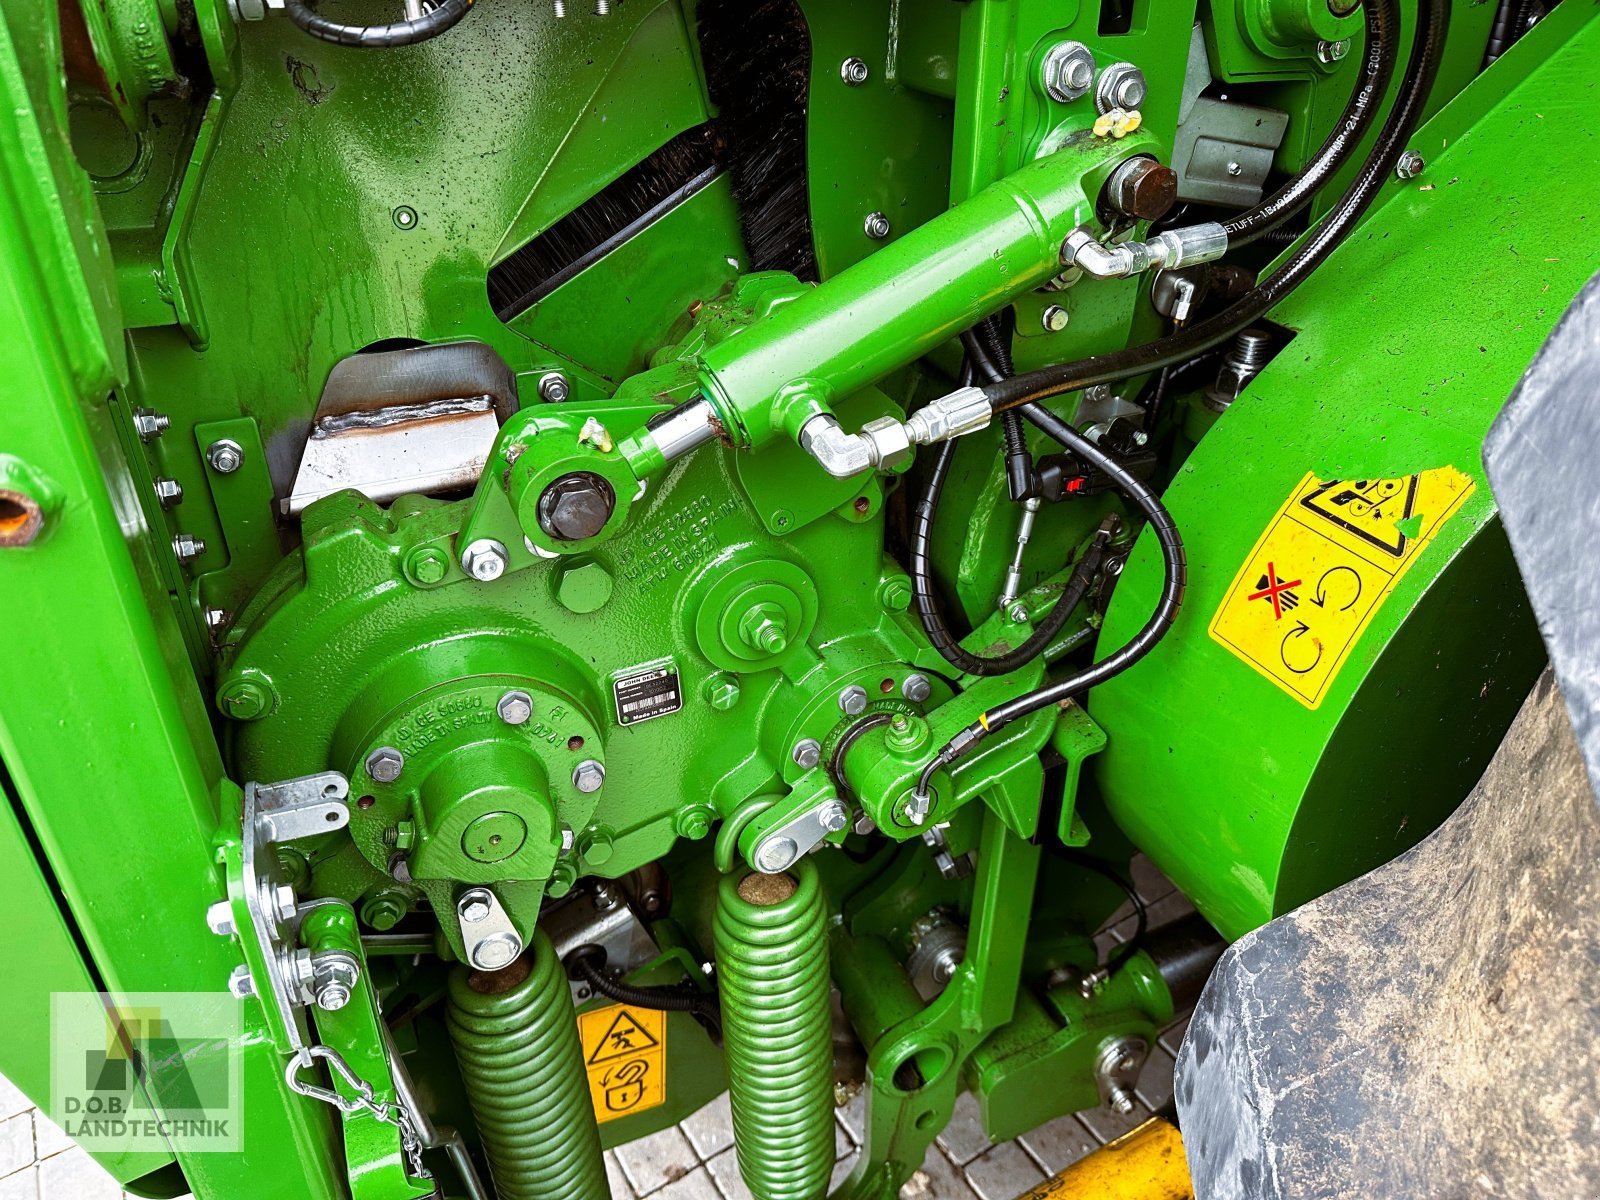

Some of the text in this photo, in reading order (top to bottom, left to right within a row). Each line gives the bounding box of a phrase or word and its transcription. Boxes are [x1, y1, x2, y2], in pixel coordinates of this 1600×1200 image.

[1355, 85, 1373, 108] MPa
[624, 499, 739, 582] MADE IN SPAIN
[623, 679, 641, 687] JOHN
[633, 712, 651, 720] Made
[658, 705, 677, 713] Spain
[404, 711, 493, 758] MADE IN SPAIN
